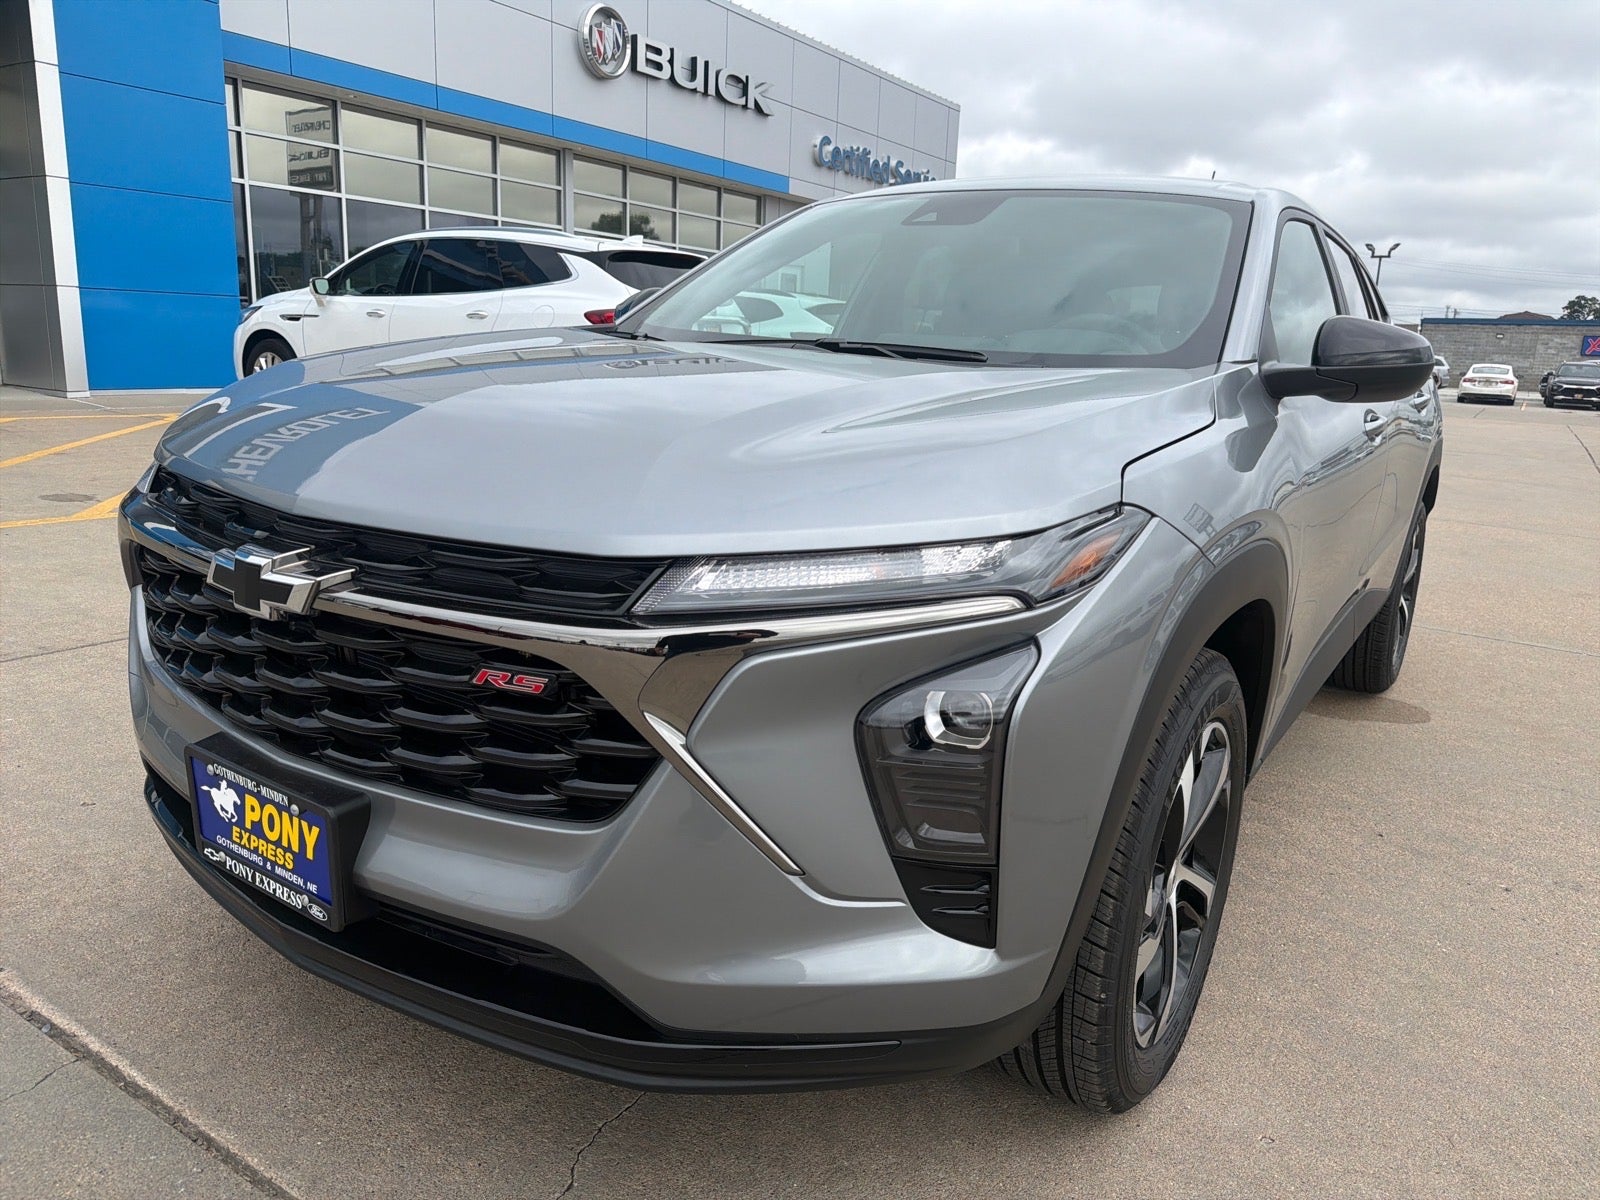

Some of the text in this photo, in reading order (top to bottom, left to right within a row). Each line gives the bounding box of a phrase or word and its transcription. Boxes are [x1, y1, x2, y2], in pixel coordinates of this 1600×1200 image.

[631, 33, 774, 117] BUICK
[816, 135, 890, 185] Certified
[473, 668, 549, 694] RS
[213, 763, 289, 808] GOTHENBURG-MINDEN
[232, 825, 294, 870] EXPRESS
[245, 793, 320, 861] PONY
[216, 835, 318, 894] GOTHENBURG & MINDEN, NE
[226, 855, 302, 910] PONY EXPRESS
